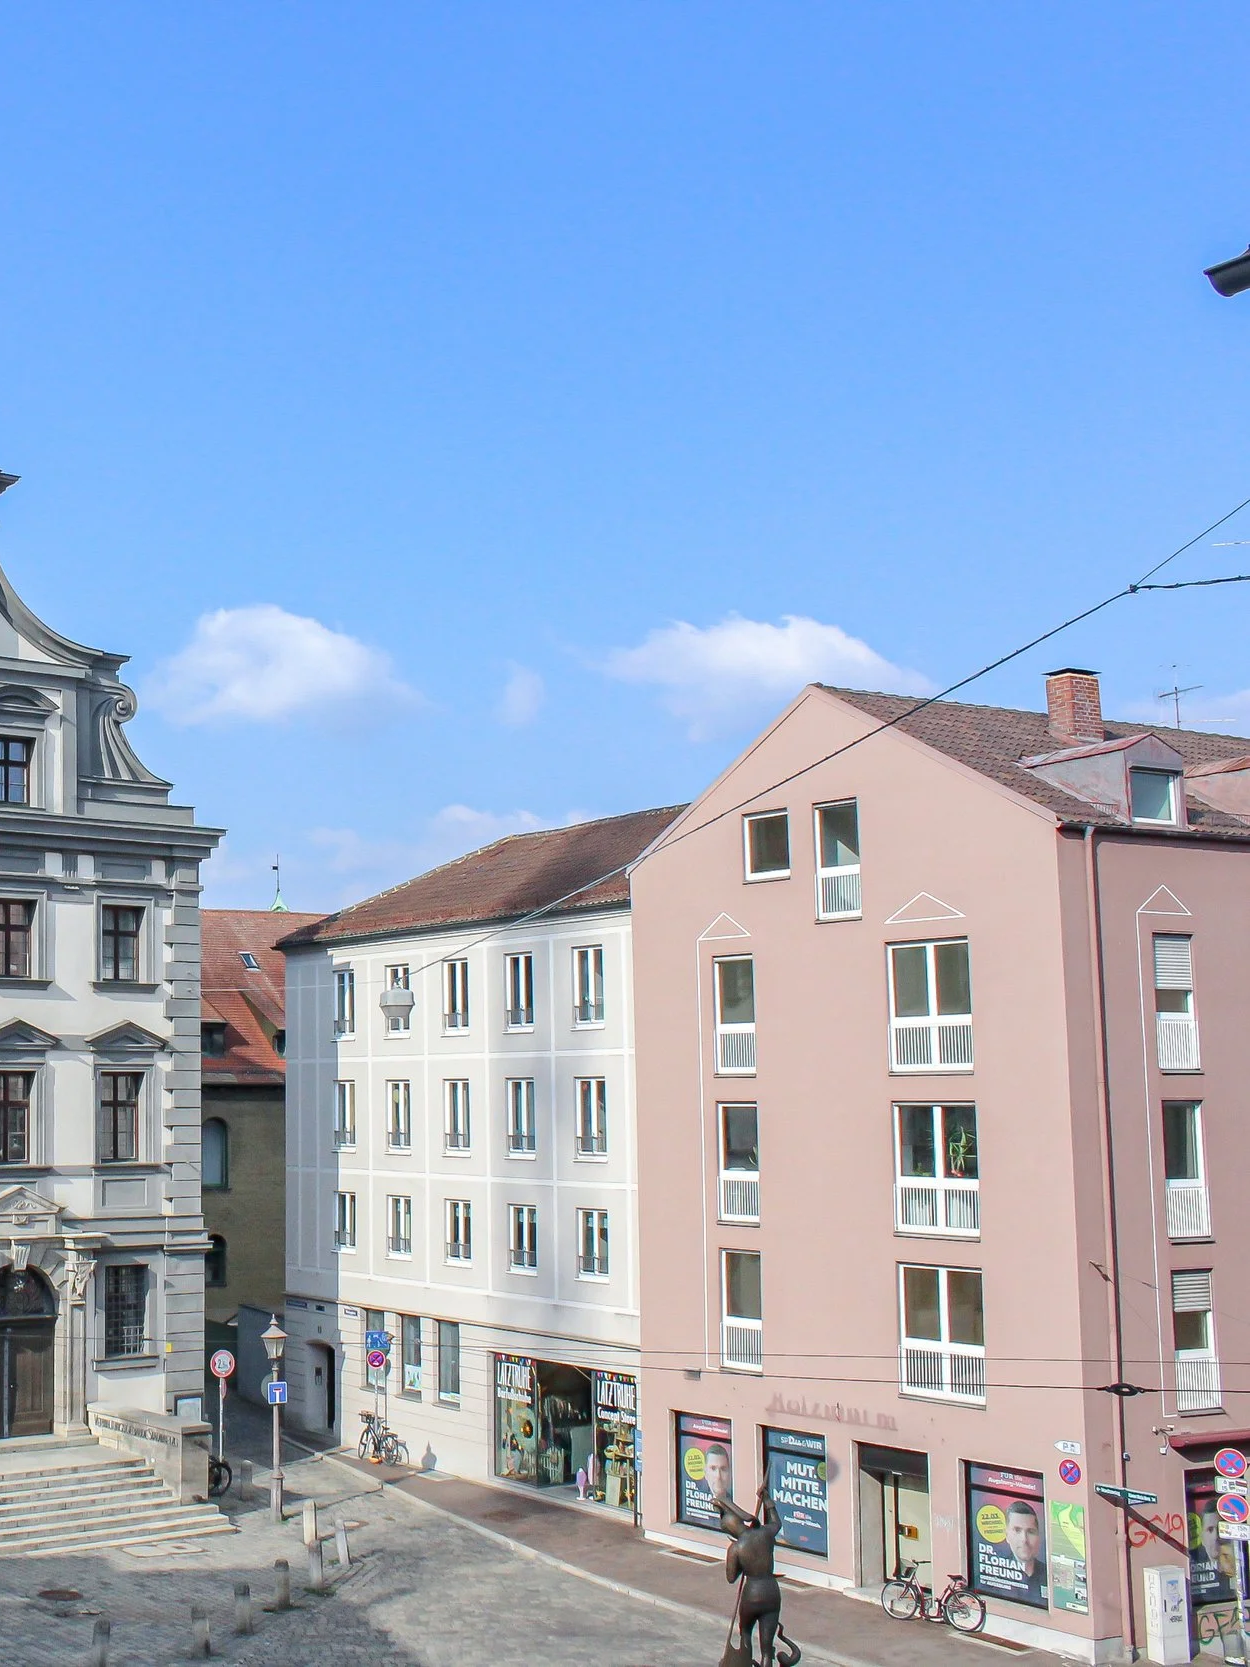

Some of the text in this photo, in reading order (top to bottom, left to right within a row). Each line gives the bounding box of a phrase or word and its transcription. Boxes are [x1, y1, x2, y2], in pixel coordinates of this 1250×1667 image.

[596, 1379, 636, 1411] LATZTRUHE
[596, 1406, 636, 1426] Concept Store
[786, 1461, 817, 1479] MUT.
[685, 1480, 698, 1490] DR.
[780, 1475, 824, 1496] MITTE.
[685, 1489, 716, 1502] FLORIA
[773, 1489, 827, 1512] MACHEN
[978, 1543, 997, 1555] DR.
[978, 1553, 1026, 1572] FLORIAN
[979, 1564, 1023, 1581] FREUND
